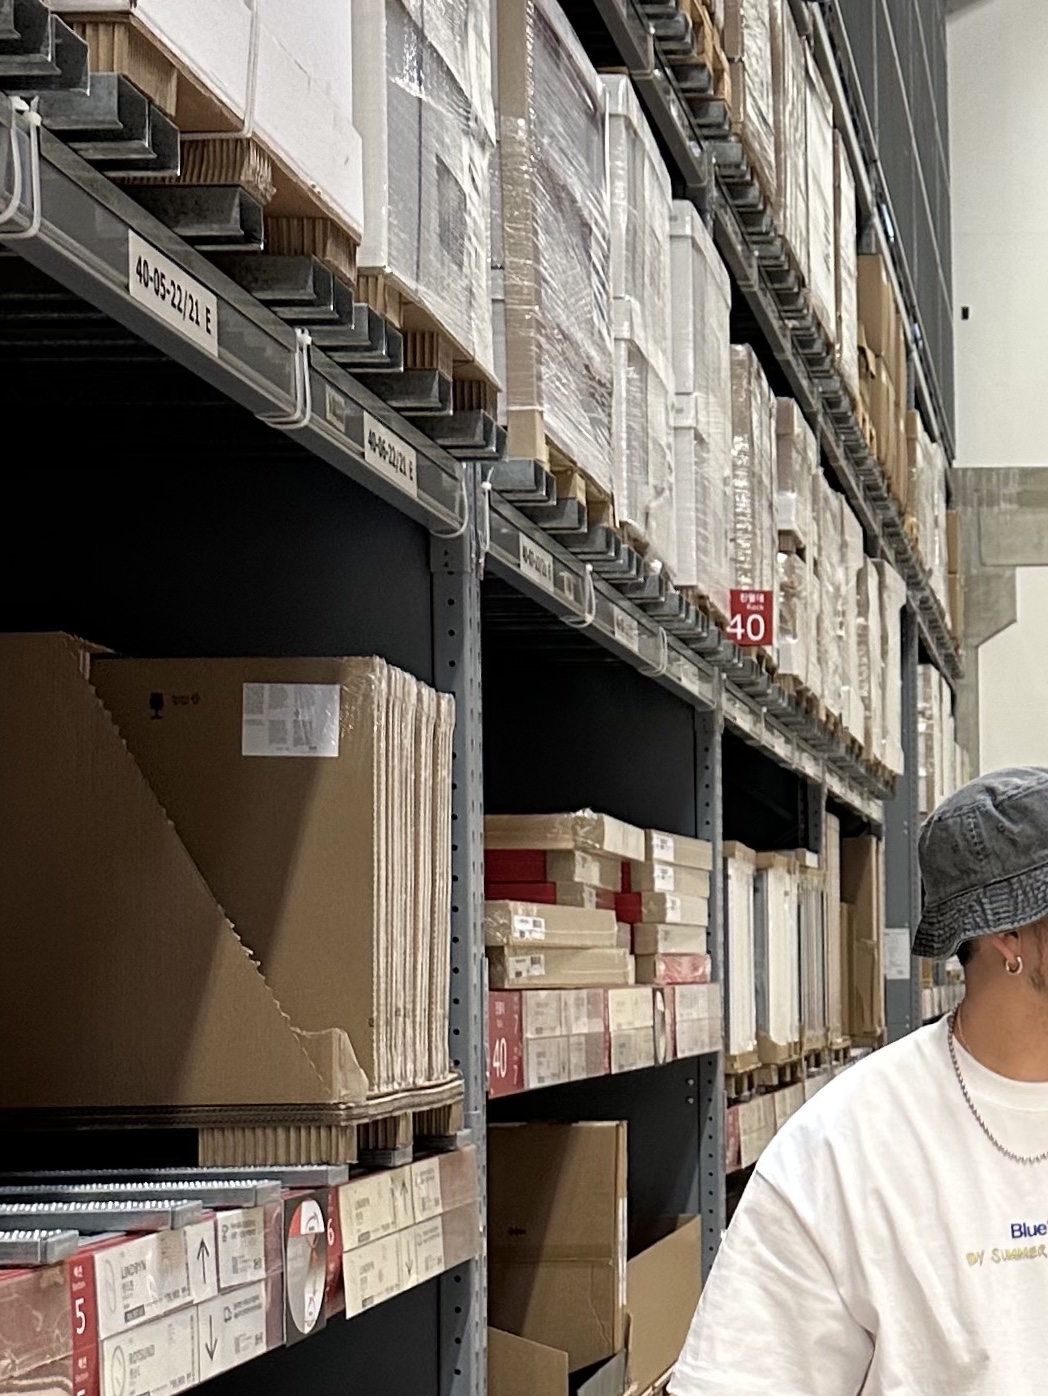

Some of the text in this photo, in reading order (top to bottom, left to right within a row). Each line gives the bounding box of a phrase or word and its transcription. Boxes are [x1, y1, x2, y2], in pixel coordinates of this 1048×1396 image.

[136, 255, 212, 335] 40-05-22/21 E
[726, 613, 765, 641] 40
[493, 1037, 507, 1078] 40
[966, 1250, 984, 1267] BY
[991, 1244, 1048, 1264] SUMMER
[75, 1297, 86, 1335] 5
